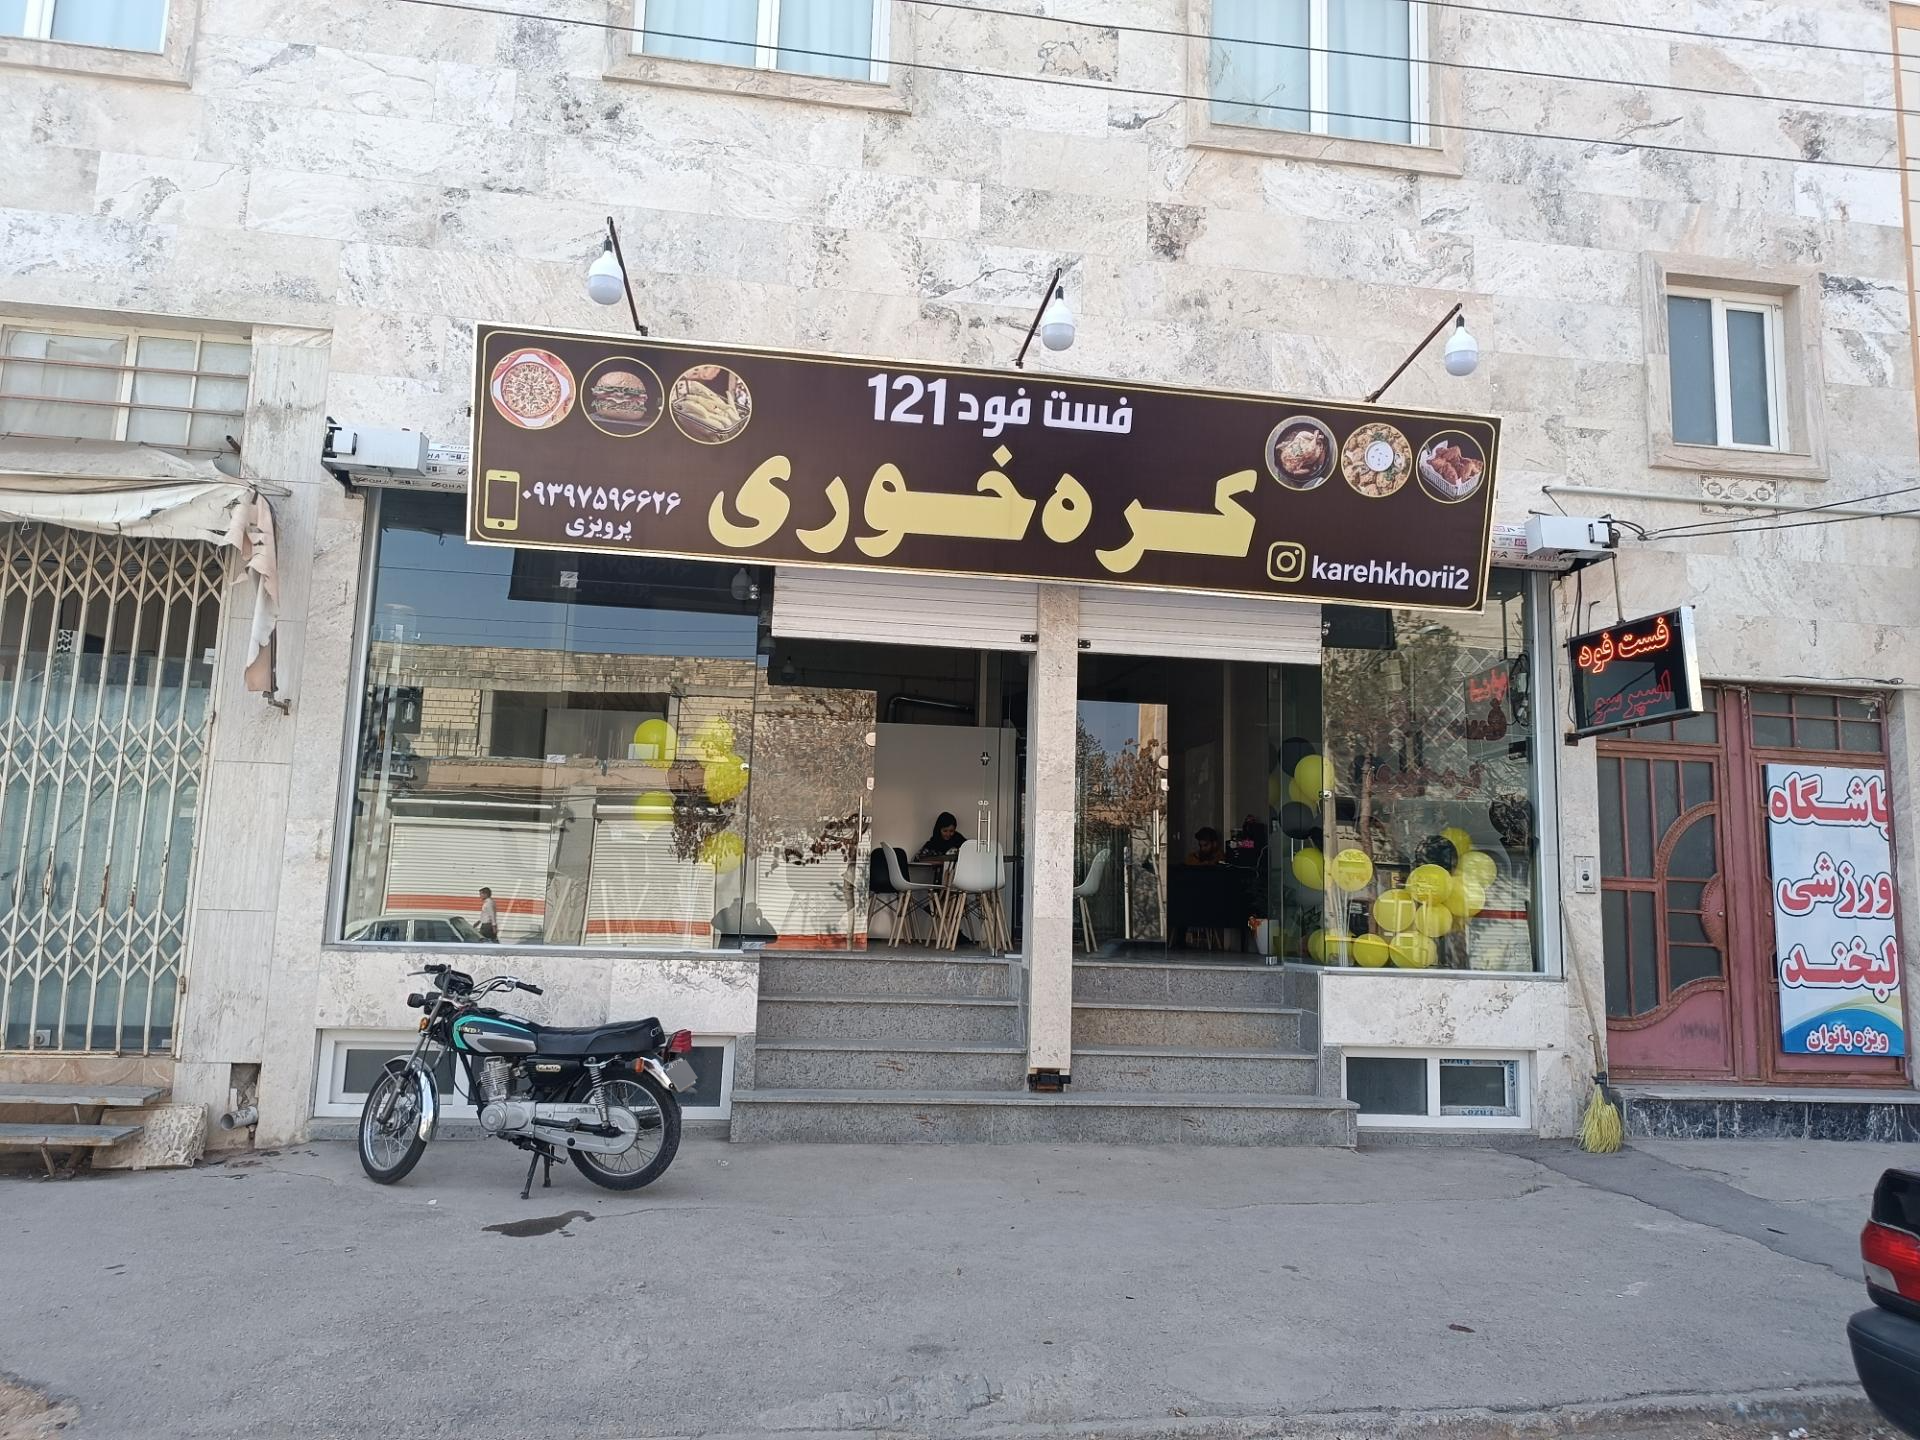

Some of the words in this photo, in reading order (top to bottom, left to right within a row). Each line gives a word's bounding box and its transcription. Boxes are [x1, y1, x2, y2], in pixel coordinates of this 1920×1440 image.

[868, 374, 947, 426] 121
[958, 388, 1031, 438] فود
[1044, 391, 1132, 434] فست
[523, 481, 682, 515] ۰۹۳۹۷۵۹۶۶۲۶
[565, 515, 633, 541] پرویزی
[1312, 555, 1470, 590] karehkhorii2
[1578, 632, 1614, 674] فود
[1618, 616, 1670, 658] فست
[1781, 856, 1893, 914] ورزشی
[1785, 941, 1897, 997] لبخند
[1807, 1024, 1852, 1051] بانوان
[1854, 1028, 1889, 1052] ویژه
